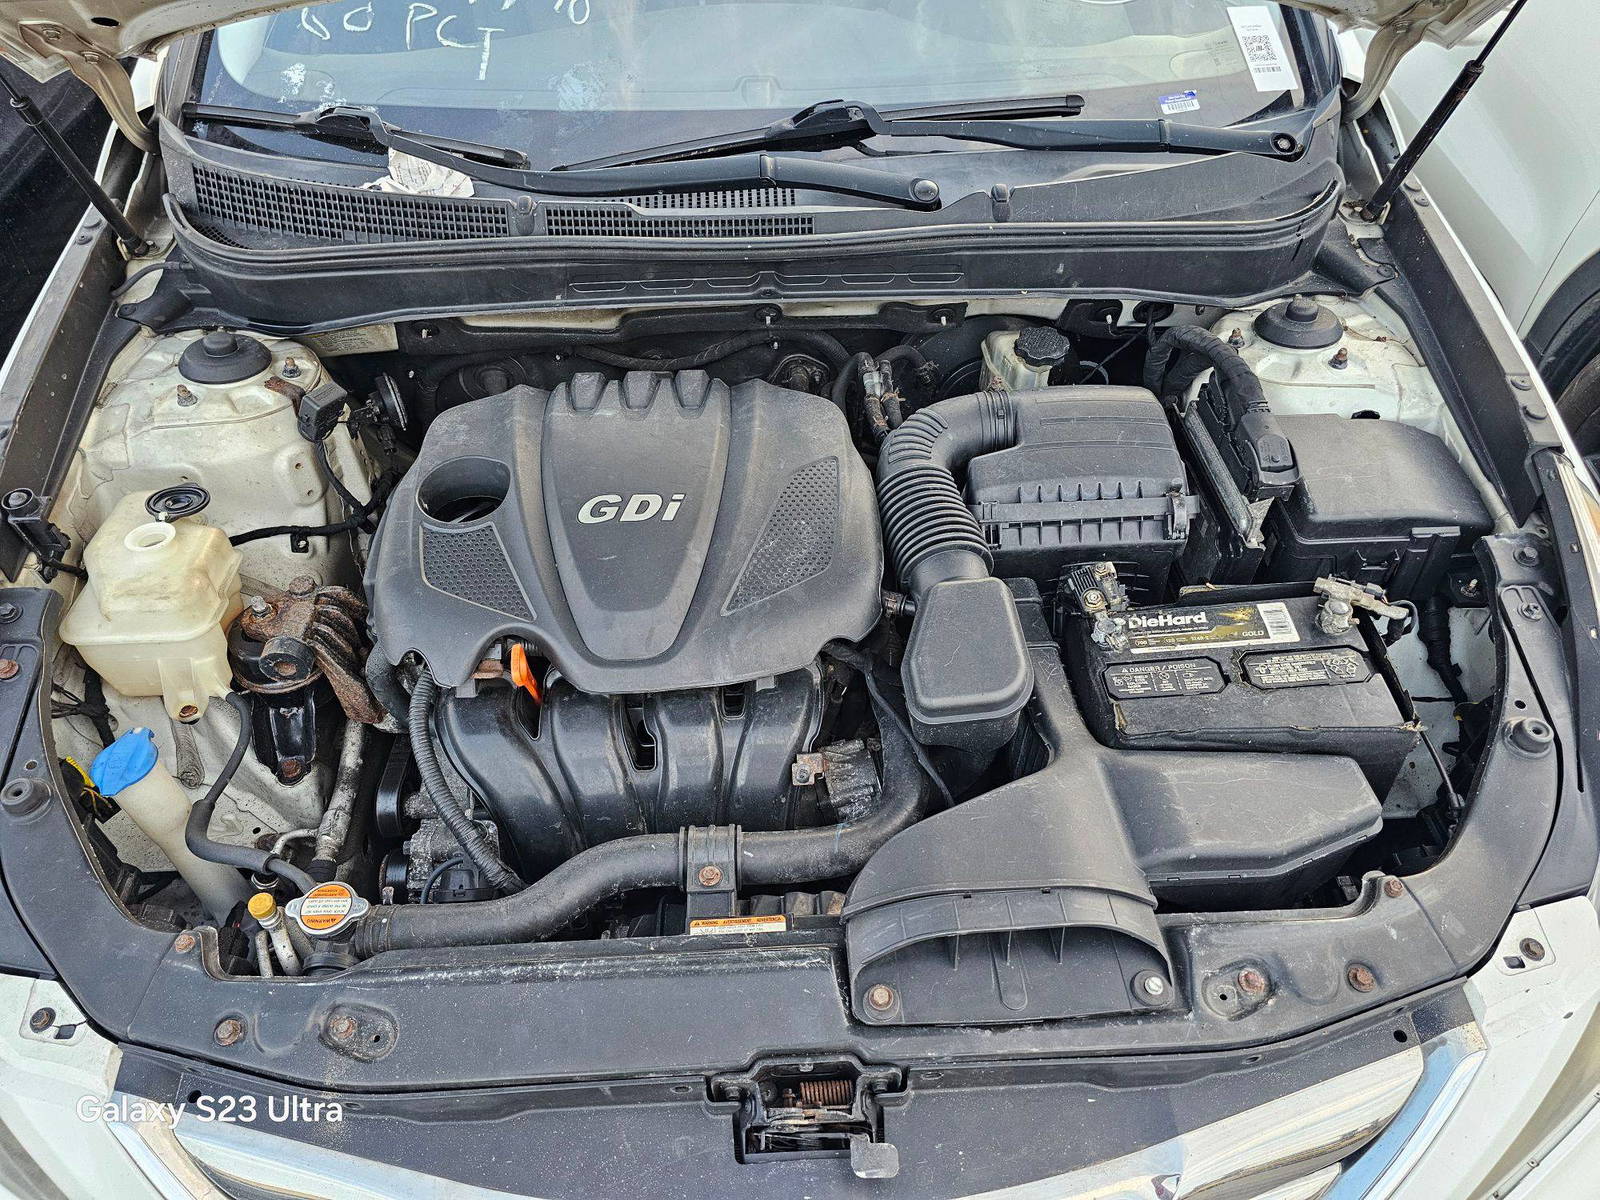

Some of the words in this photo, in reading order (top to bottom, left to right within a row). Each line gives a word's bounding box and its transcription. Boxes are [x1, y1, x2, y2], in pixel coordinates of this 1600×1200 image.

[405, 3, 505, 81] PCT
[577, 493, 686, 524] GDi
[1128, 611, 1208, 629] DieHard
[1129, 665, 1161, 673] DANGER
